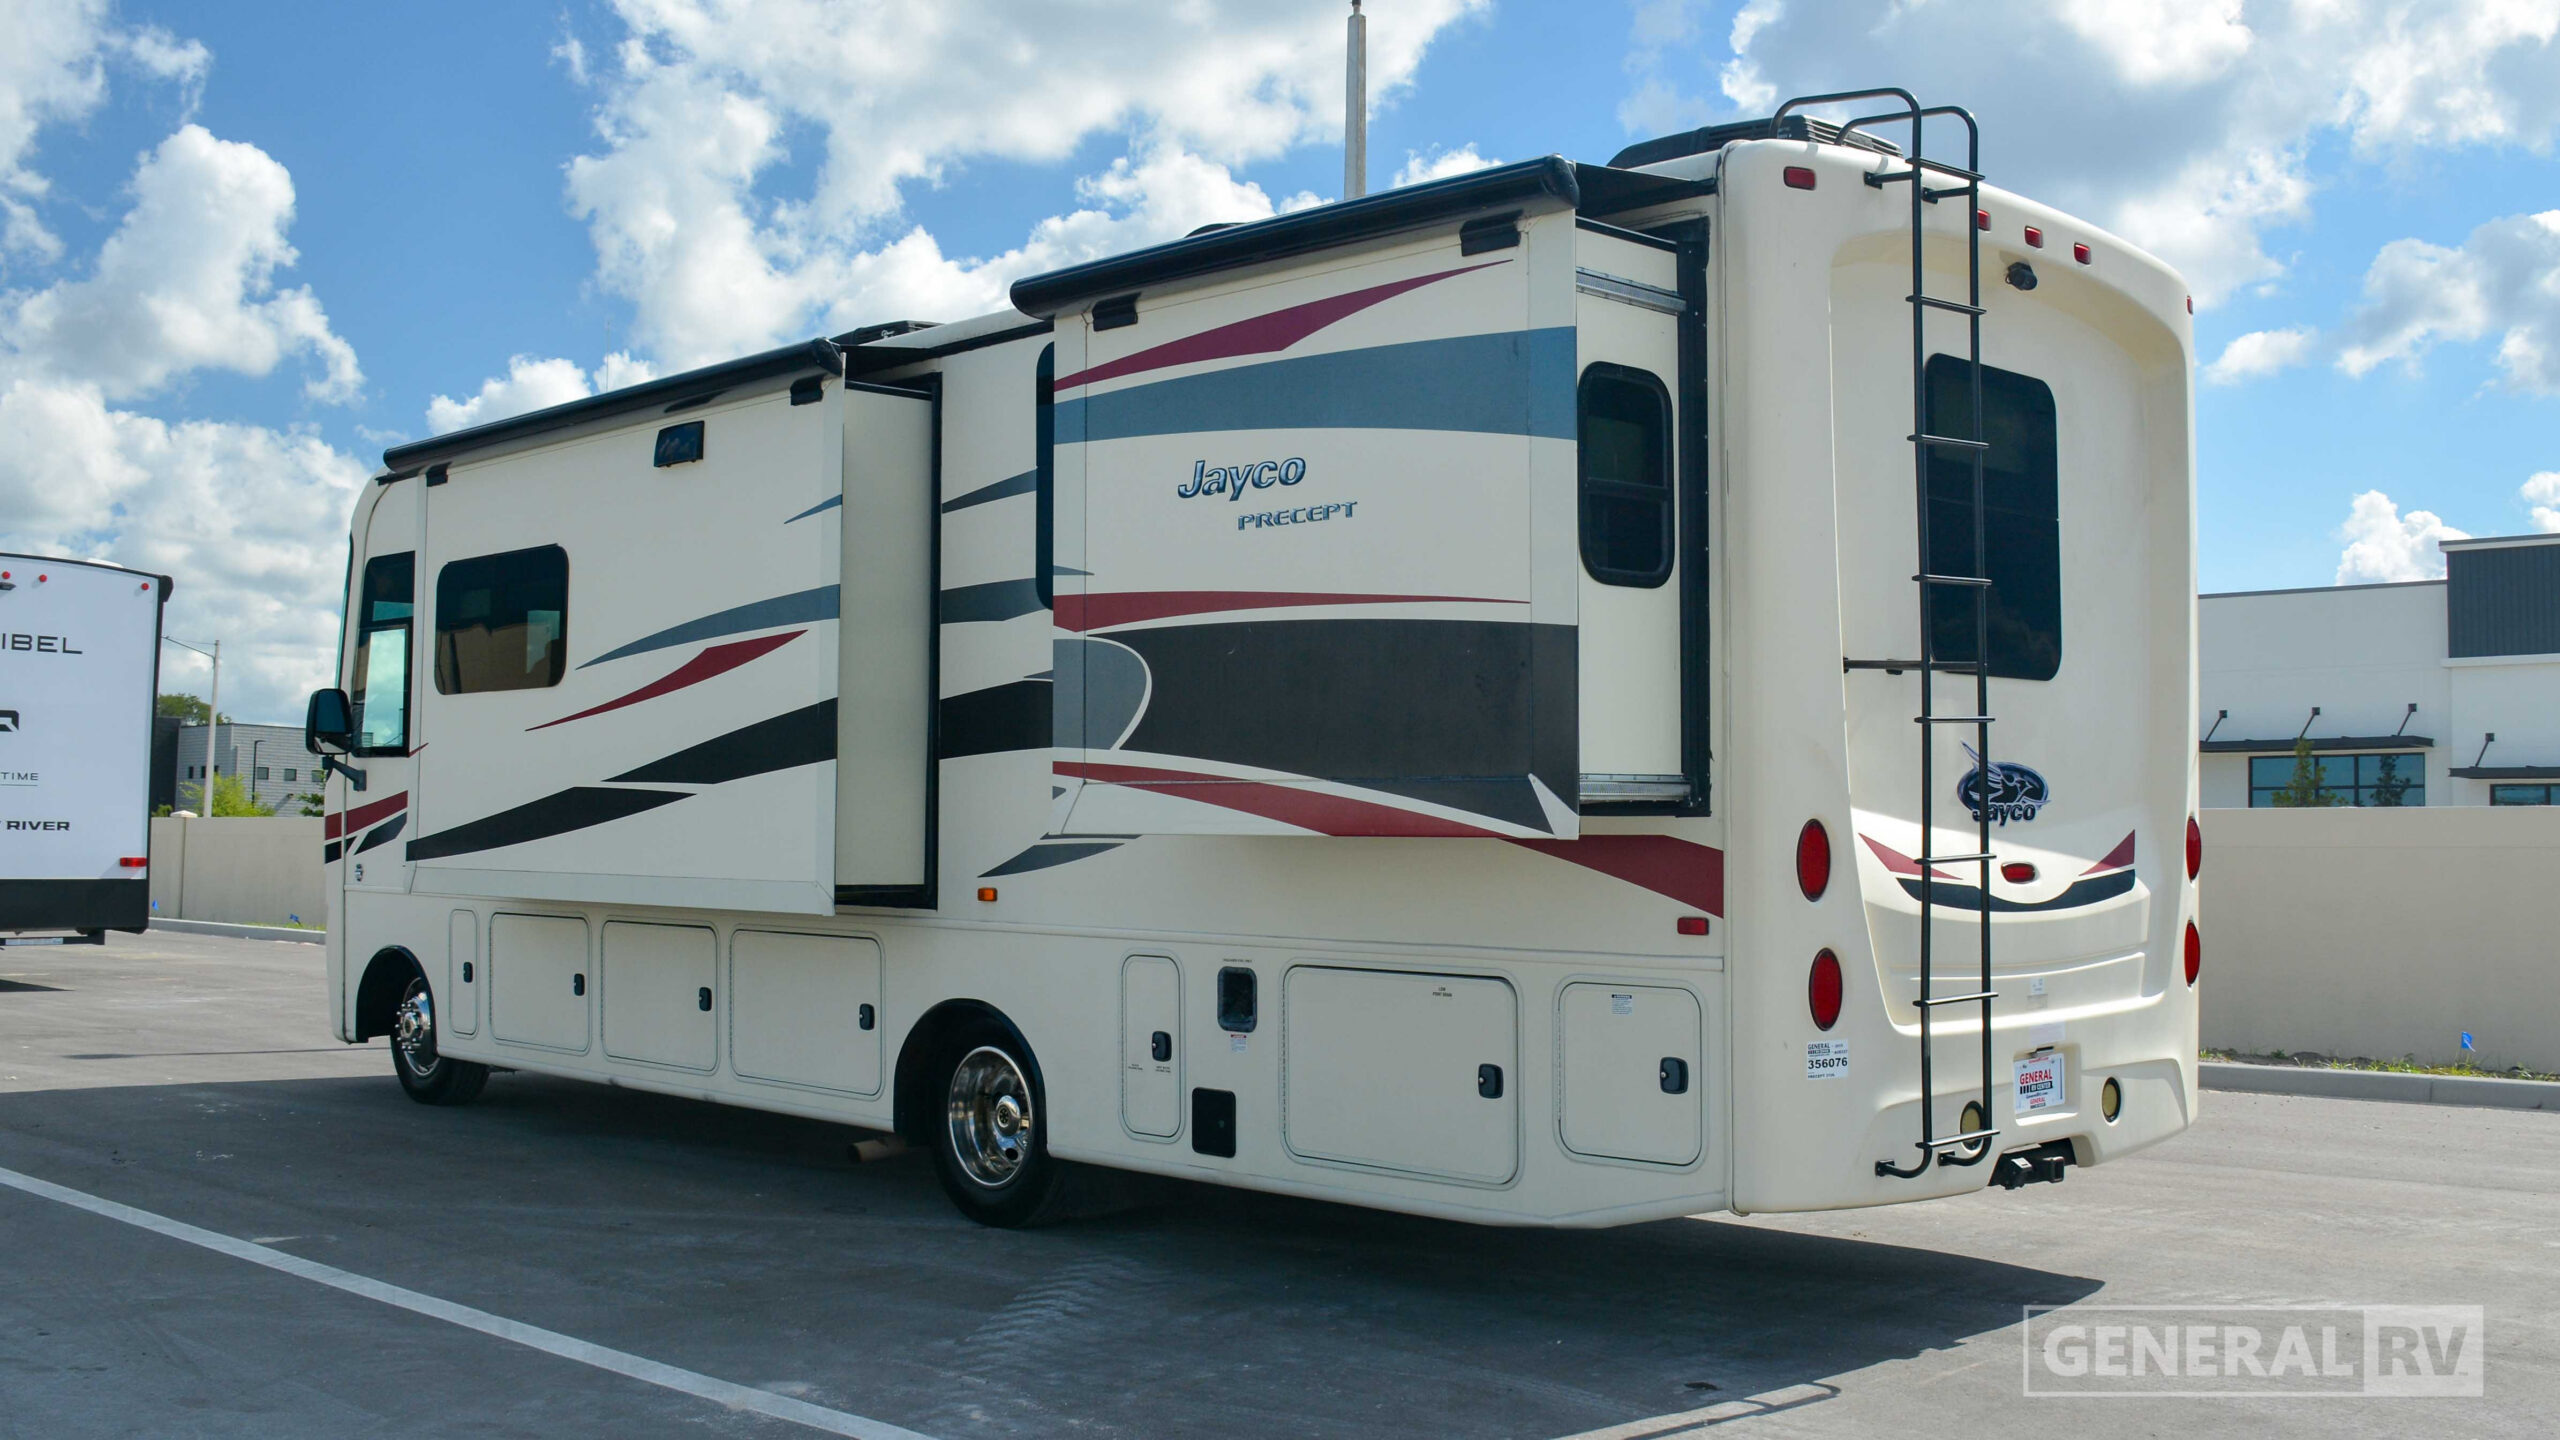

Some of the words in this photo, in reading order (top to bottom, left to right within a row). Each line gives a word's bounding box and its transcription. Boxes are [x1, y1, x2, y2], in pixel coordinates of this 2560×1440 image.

[1178, 457, 1306, 501] Jayco
[1238, 501, 1358, 530] PRECEPT
[1, 772, 39, 781] TIME
[6, 820, 70, 831] RIVER
[1808, 1057, 1848, 1069] 356076
[2019, 1069, 2053, 1085] GENERAL
